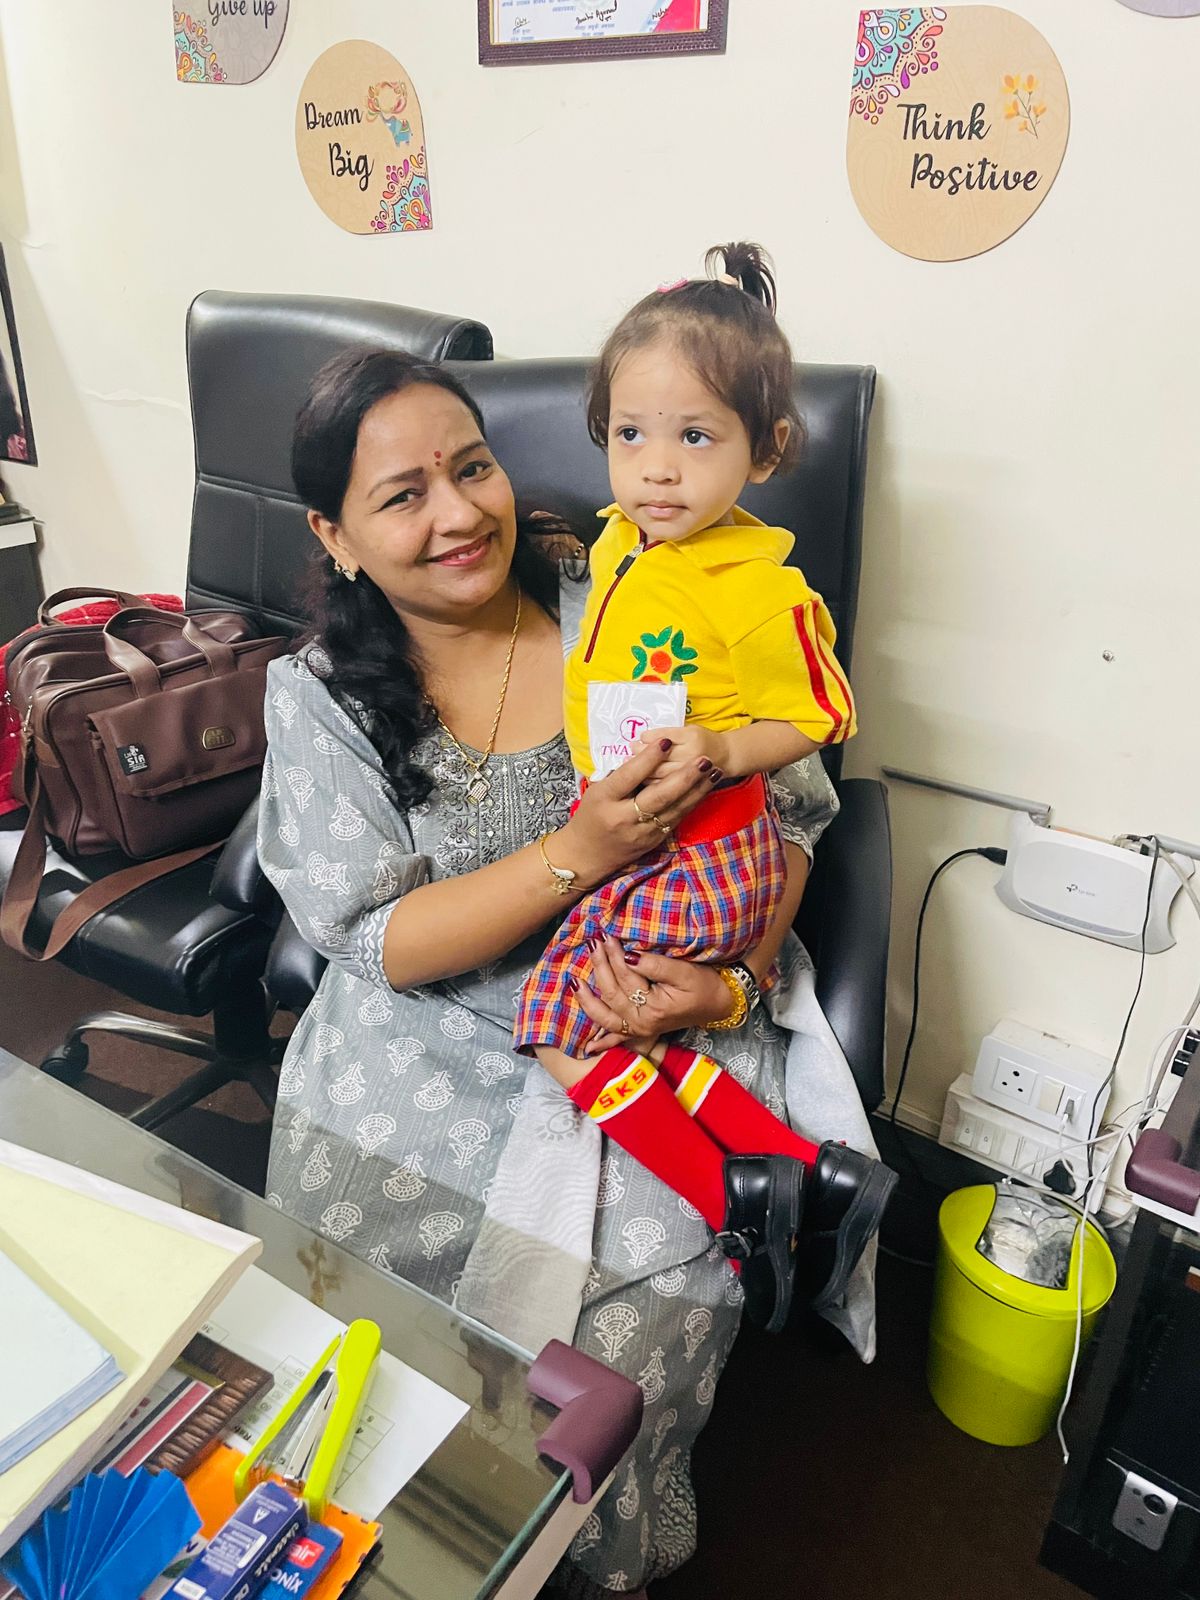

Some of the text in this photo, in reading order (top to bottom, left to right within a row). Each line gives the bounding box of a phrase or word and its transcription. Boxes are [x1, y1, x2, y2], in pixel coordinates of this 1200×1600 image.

[253, 0, 277, 29] up
[304, 102, 364, 130] Dream
[897, 103, 991, 140] Think
[328, 142, 375, 191] Big
[910, 153, 1042, 195] Positive
[601, 744, 635, 756] TWA
[598, 1069, 646, 1108] SKS
[288, 1541, 316, 1561] air
